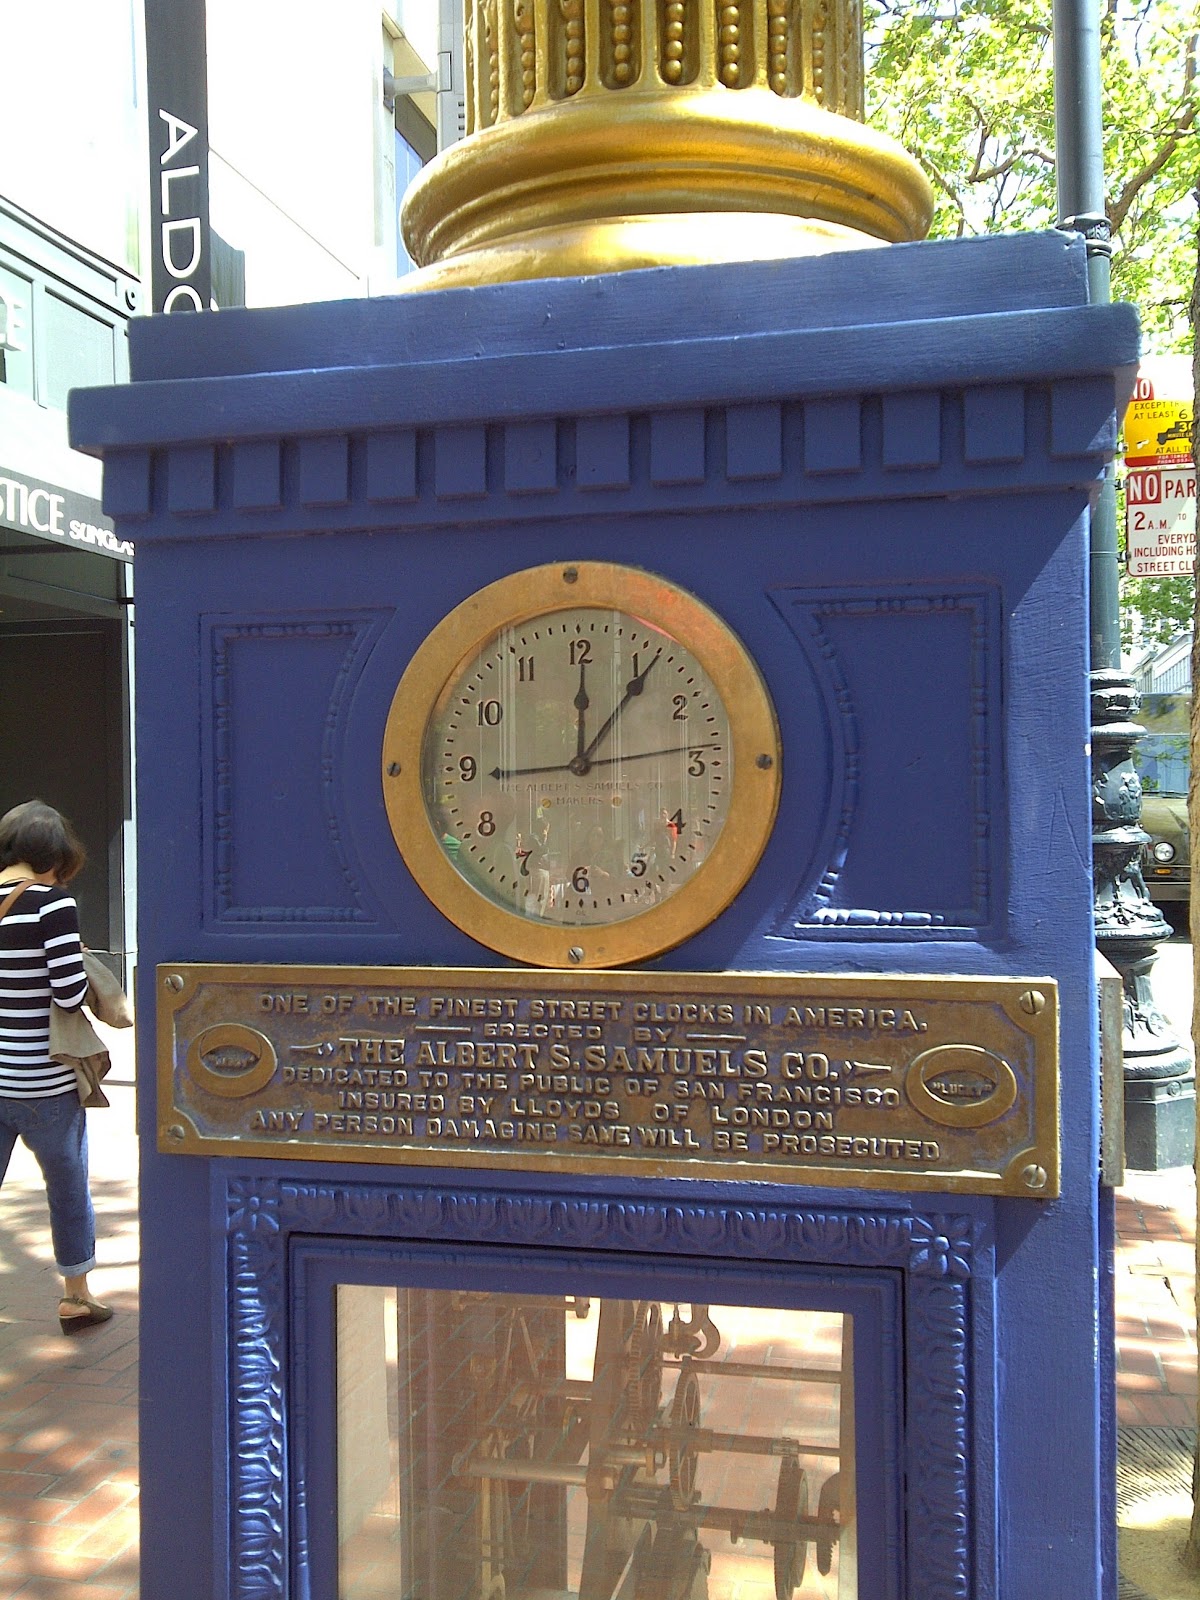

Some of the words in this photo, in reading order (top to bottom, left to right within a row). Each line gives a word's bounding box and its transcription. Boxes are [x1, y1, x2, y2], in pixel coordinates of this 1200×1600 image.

[1134, 401, 1166, 410] EXCEPT
[1147, 411, 1174, 419] LEAST
[1129, 474, 1158, 502] NO
[0, 476, 65, 536] TICE
[1134, 511, 1146, 531] 2
[1148, 519, 1171, 530] A.M.
[1134, 545, 1184, 558] INCLUDING
[1137, 561, 1175, 573] STREET
[569, 639, 593, 666] 12
[632, 652, 640, 678] 1
[518, 656, 535, 682] 11
[477, 700, 503, 727] 10
[672, 694, 689, 721] 2
[459, 756, 477, 782] 9
[687, 750, 706, 777] 3
[556, 797, 602, 805] MAKERS
[477, 811, 497, 837] 8
[666, 808, 687, 835] 4
[515, 849, 533, 876] 7
[631, 853, 648, 878] 5
[572, 866, 590, 893] 6
[258, 993, 309, 1014] ONE
[320, 995, 353, 1015] OF
[367, 996, 417, 1017] THE
[429, 997, 518, 1019] FINEST
[529, 999, 621, 1021] STREET
[633, 1002, 734, 1024] CLOCKS
[744, 1005, 772, 1025] IN
[783, 1006, 928, 1031] AMERICA.
[483, 1022, 602, 1040] ERECTED
[634, 1027, 673, 1043] BY
[338, 1037, 405, 1065] THE
[415, 1041, 539, 1070] ALBERT
[781, 1051, 839, 1082] CO.
[282, 1066, 408, 1087] DEDICATED
[418, 1070, 449, 1088] TO
[460, 1072, 508, 1091] THE
[519, 1074, 610, 1095] PUBLIC
[624, 1078, 659, 1096] OF
[673, 1080, 725, 1100] SAN
[738, 1082, 900, 1106] FRANCISCO
[338, 1090, 445, 1112] INSURED
[458, 1096, 494, 1115] BY
[510, 1097, 620, 1119] LLOYDS
[653, 1103, 689, 1122] OF
[712, 1104, 833, 1130] LONDON
[251, 1110, 304, 1132] ANY
[314, 1113, 414, 1136] PERSON
[426, 1117, 557, 1141] DAMAGING
[568, 1124, 631, 1146] SAME
[637, 1127, 700, 1149] WILL
[713, 1130, 749, 1151] BE
[763, 1132, 940, 1160] PROSECUTED
